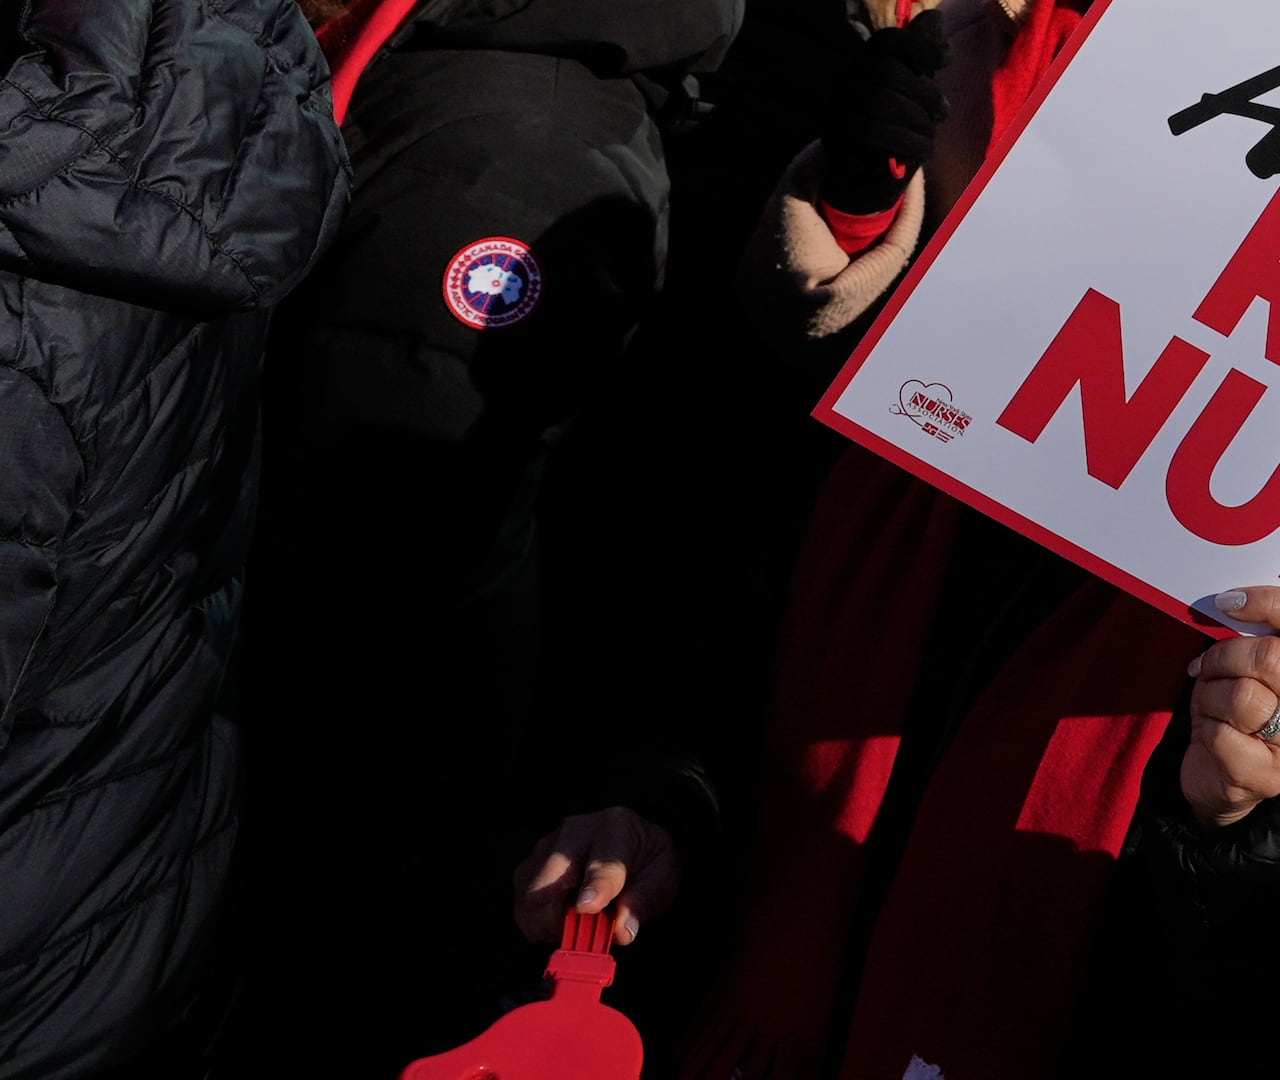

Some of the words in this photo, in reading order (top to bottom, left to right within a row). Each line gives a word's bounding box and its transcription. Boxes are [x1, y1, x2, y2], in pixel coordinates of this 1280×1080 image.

[470, 243, 513, 257] CANADA
[906, 402, 965, 437] ASSOCIATION
[909, 391, 971, 432] NURSES
